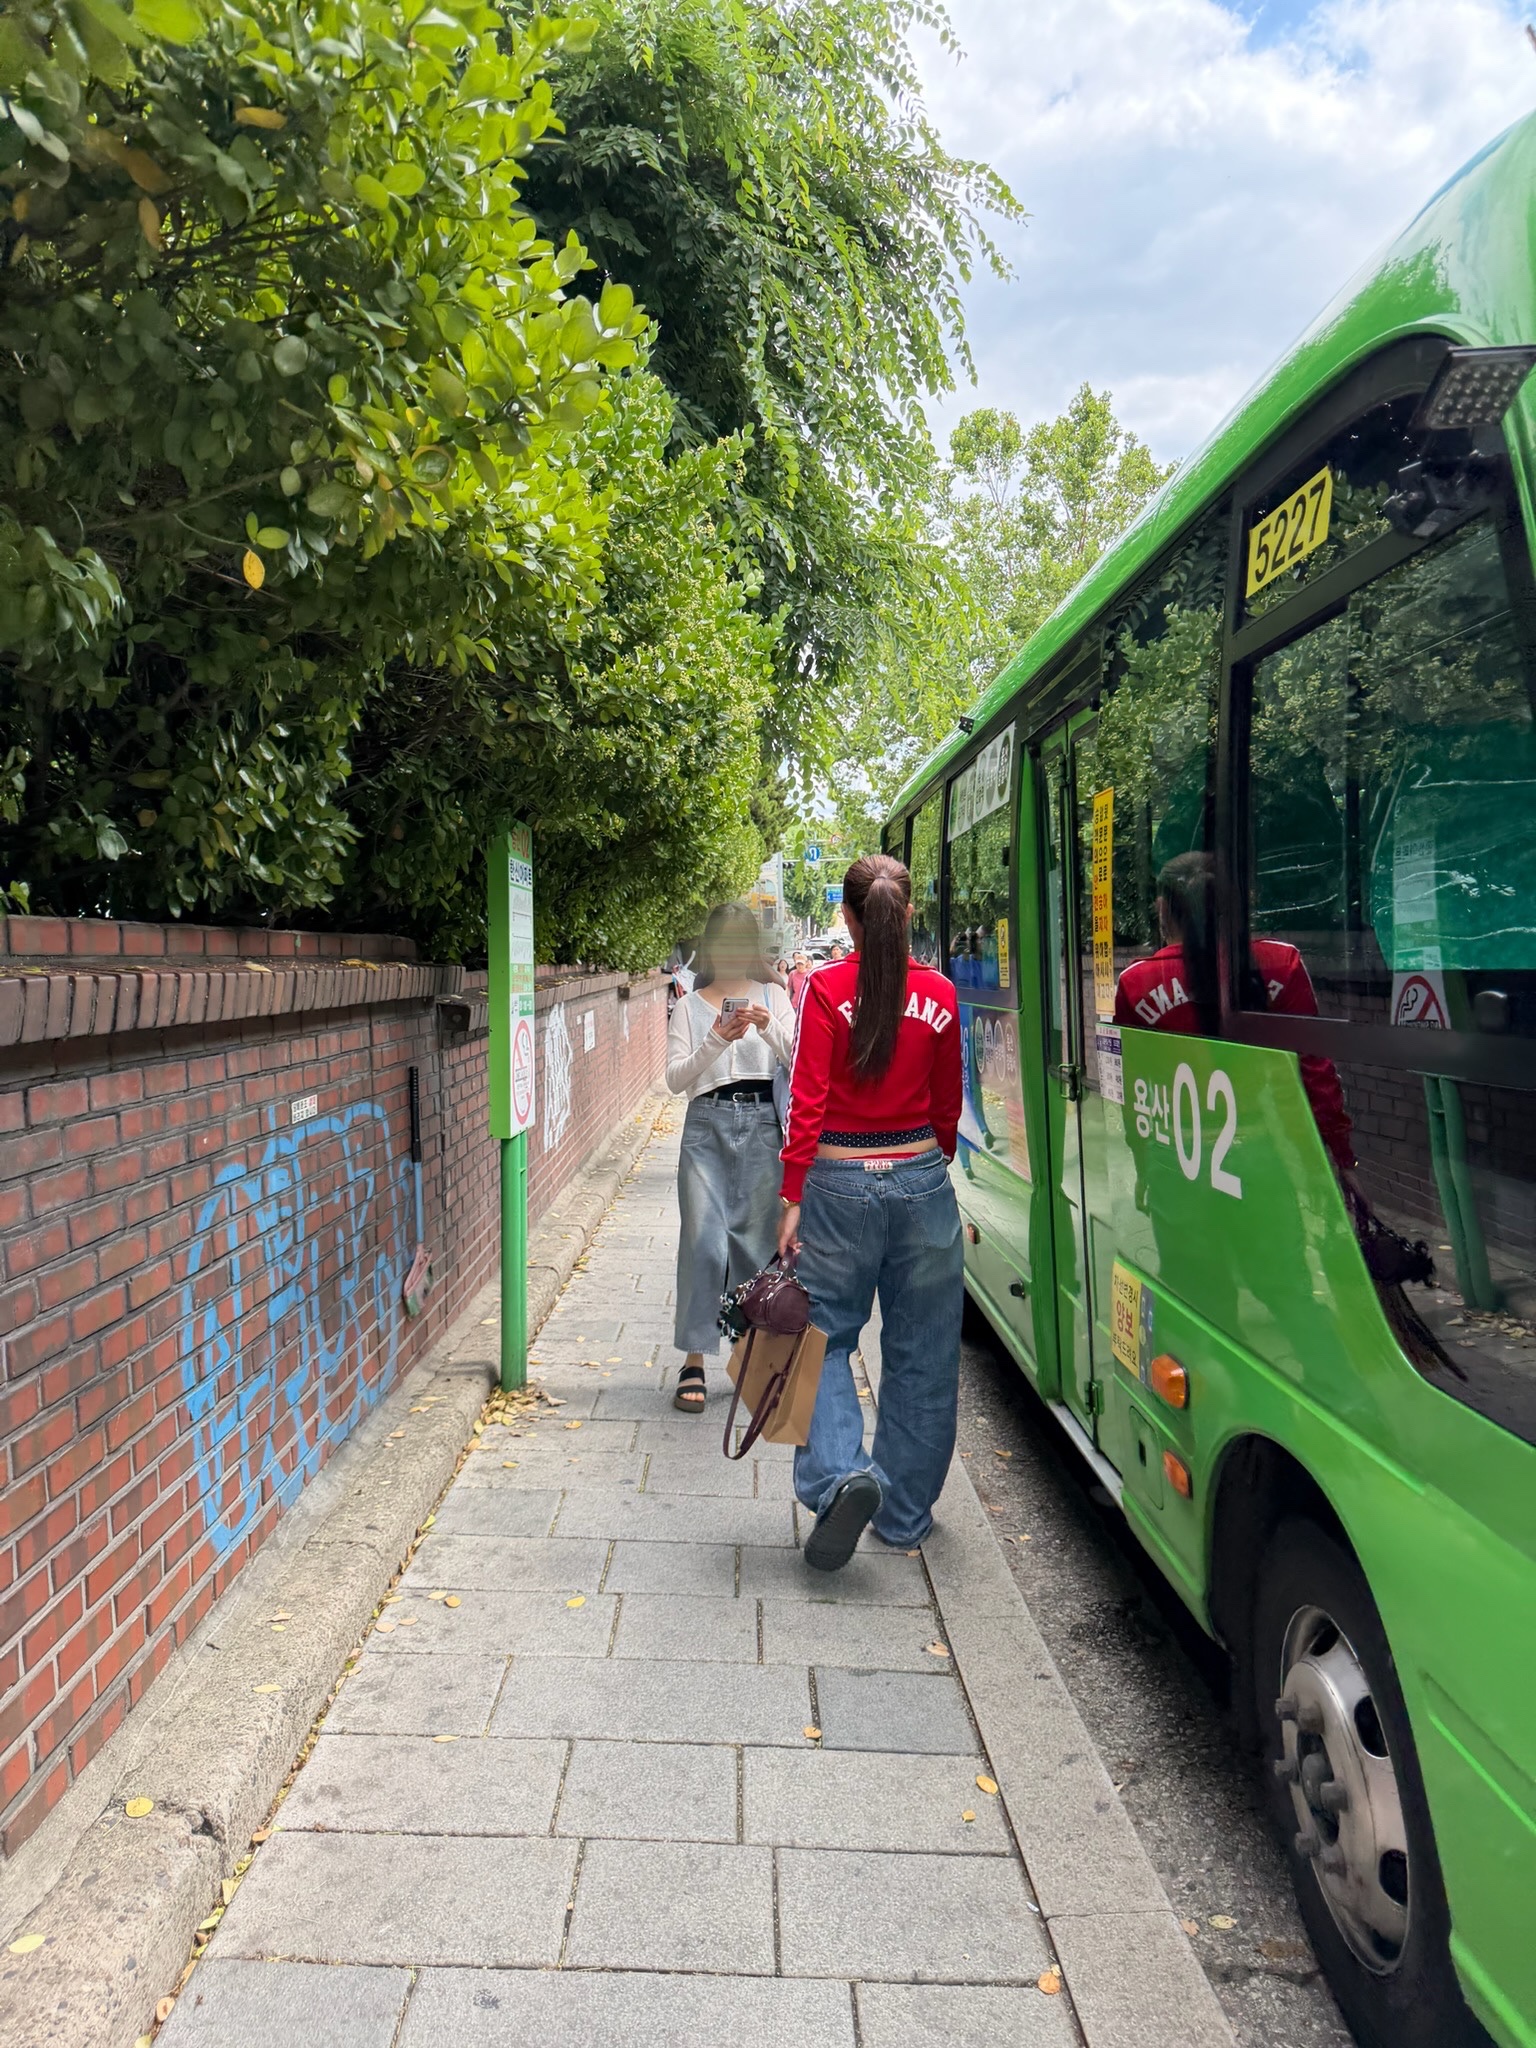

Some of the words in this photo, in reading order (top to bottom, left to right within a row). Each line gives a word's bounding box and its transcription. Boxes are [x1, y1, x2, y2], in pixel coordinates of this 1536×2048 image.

[1255, 477, 1326, 583] 5227
[1133, 1078, 1170, 1146] 용산
[1172, 1062, 1242, 1200] 02
[1116, 1299, 1134, 1339] 양보
